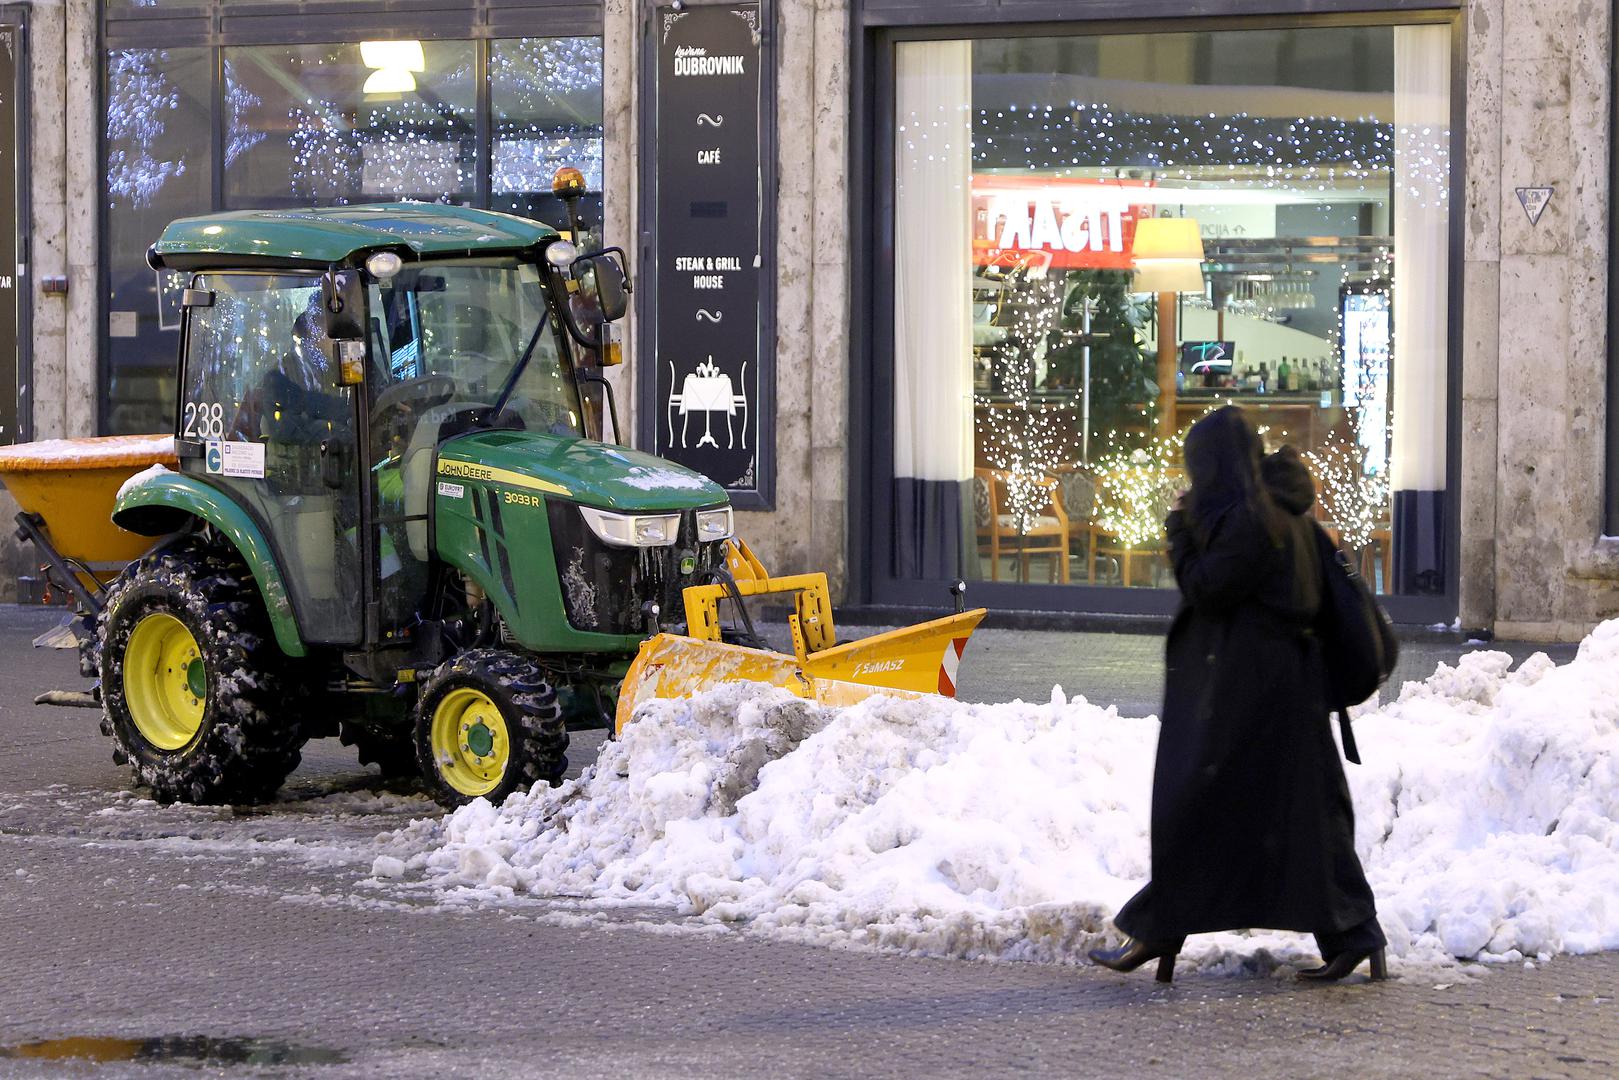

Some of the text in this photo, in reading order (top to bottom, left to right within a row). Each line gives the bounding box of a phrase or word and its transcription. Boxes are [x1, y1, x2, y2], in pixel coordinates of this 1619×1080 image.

[674, 45, 707, 58] kavana
[674, 55, 745, 76] DUBROVNIK
[697, 147, 721, 164] CAFÉ
[675, 256, 742, 271] STEAK & GRILL
[693, 275, 724, 289] HOUSE
[183, 402, 223, 438] 238
[440, 462, 492, 480] JOHN DEERE
[504, 491, 540, 507] 3033 R
